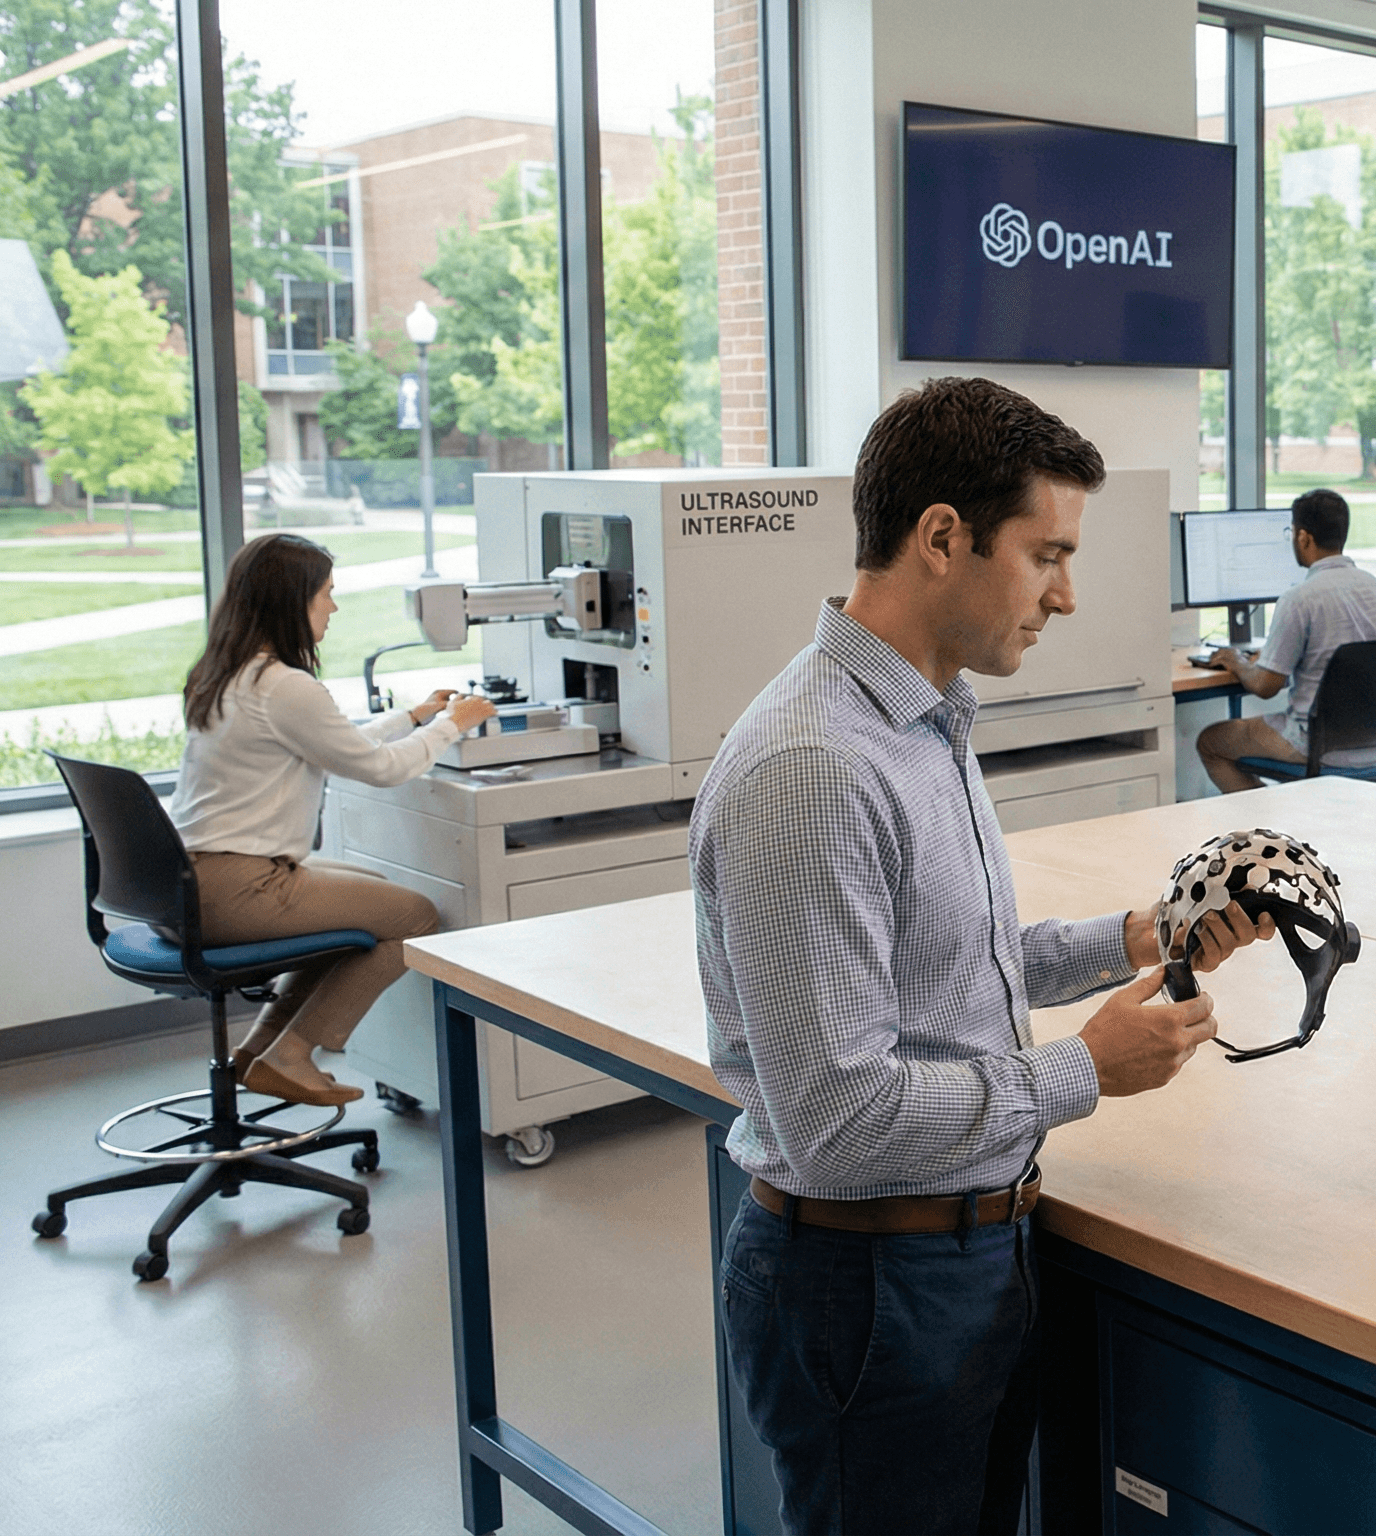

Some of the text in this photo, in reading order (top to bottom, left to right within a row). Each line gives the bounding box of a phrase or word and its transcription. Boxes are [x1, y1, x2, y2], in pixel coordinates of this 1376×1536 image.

[1037, 220, 1173, 269] OpenAI
[681, 490, 819, 511] ULTRASOUND
[682, 513, 795, 536] INTERFACE
